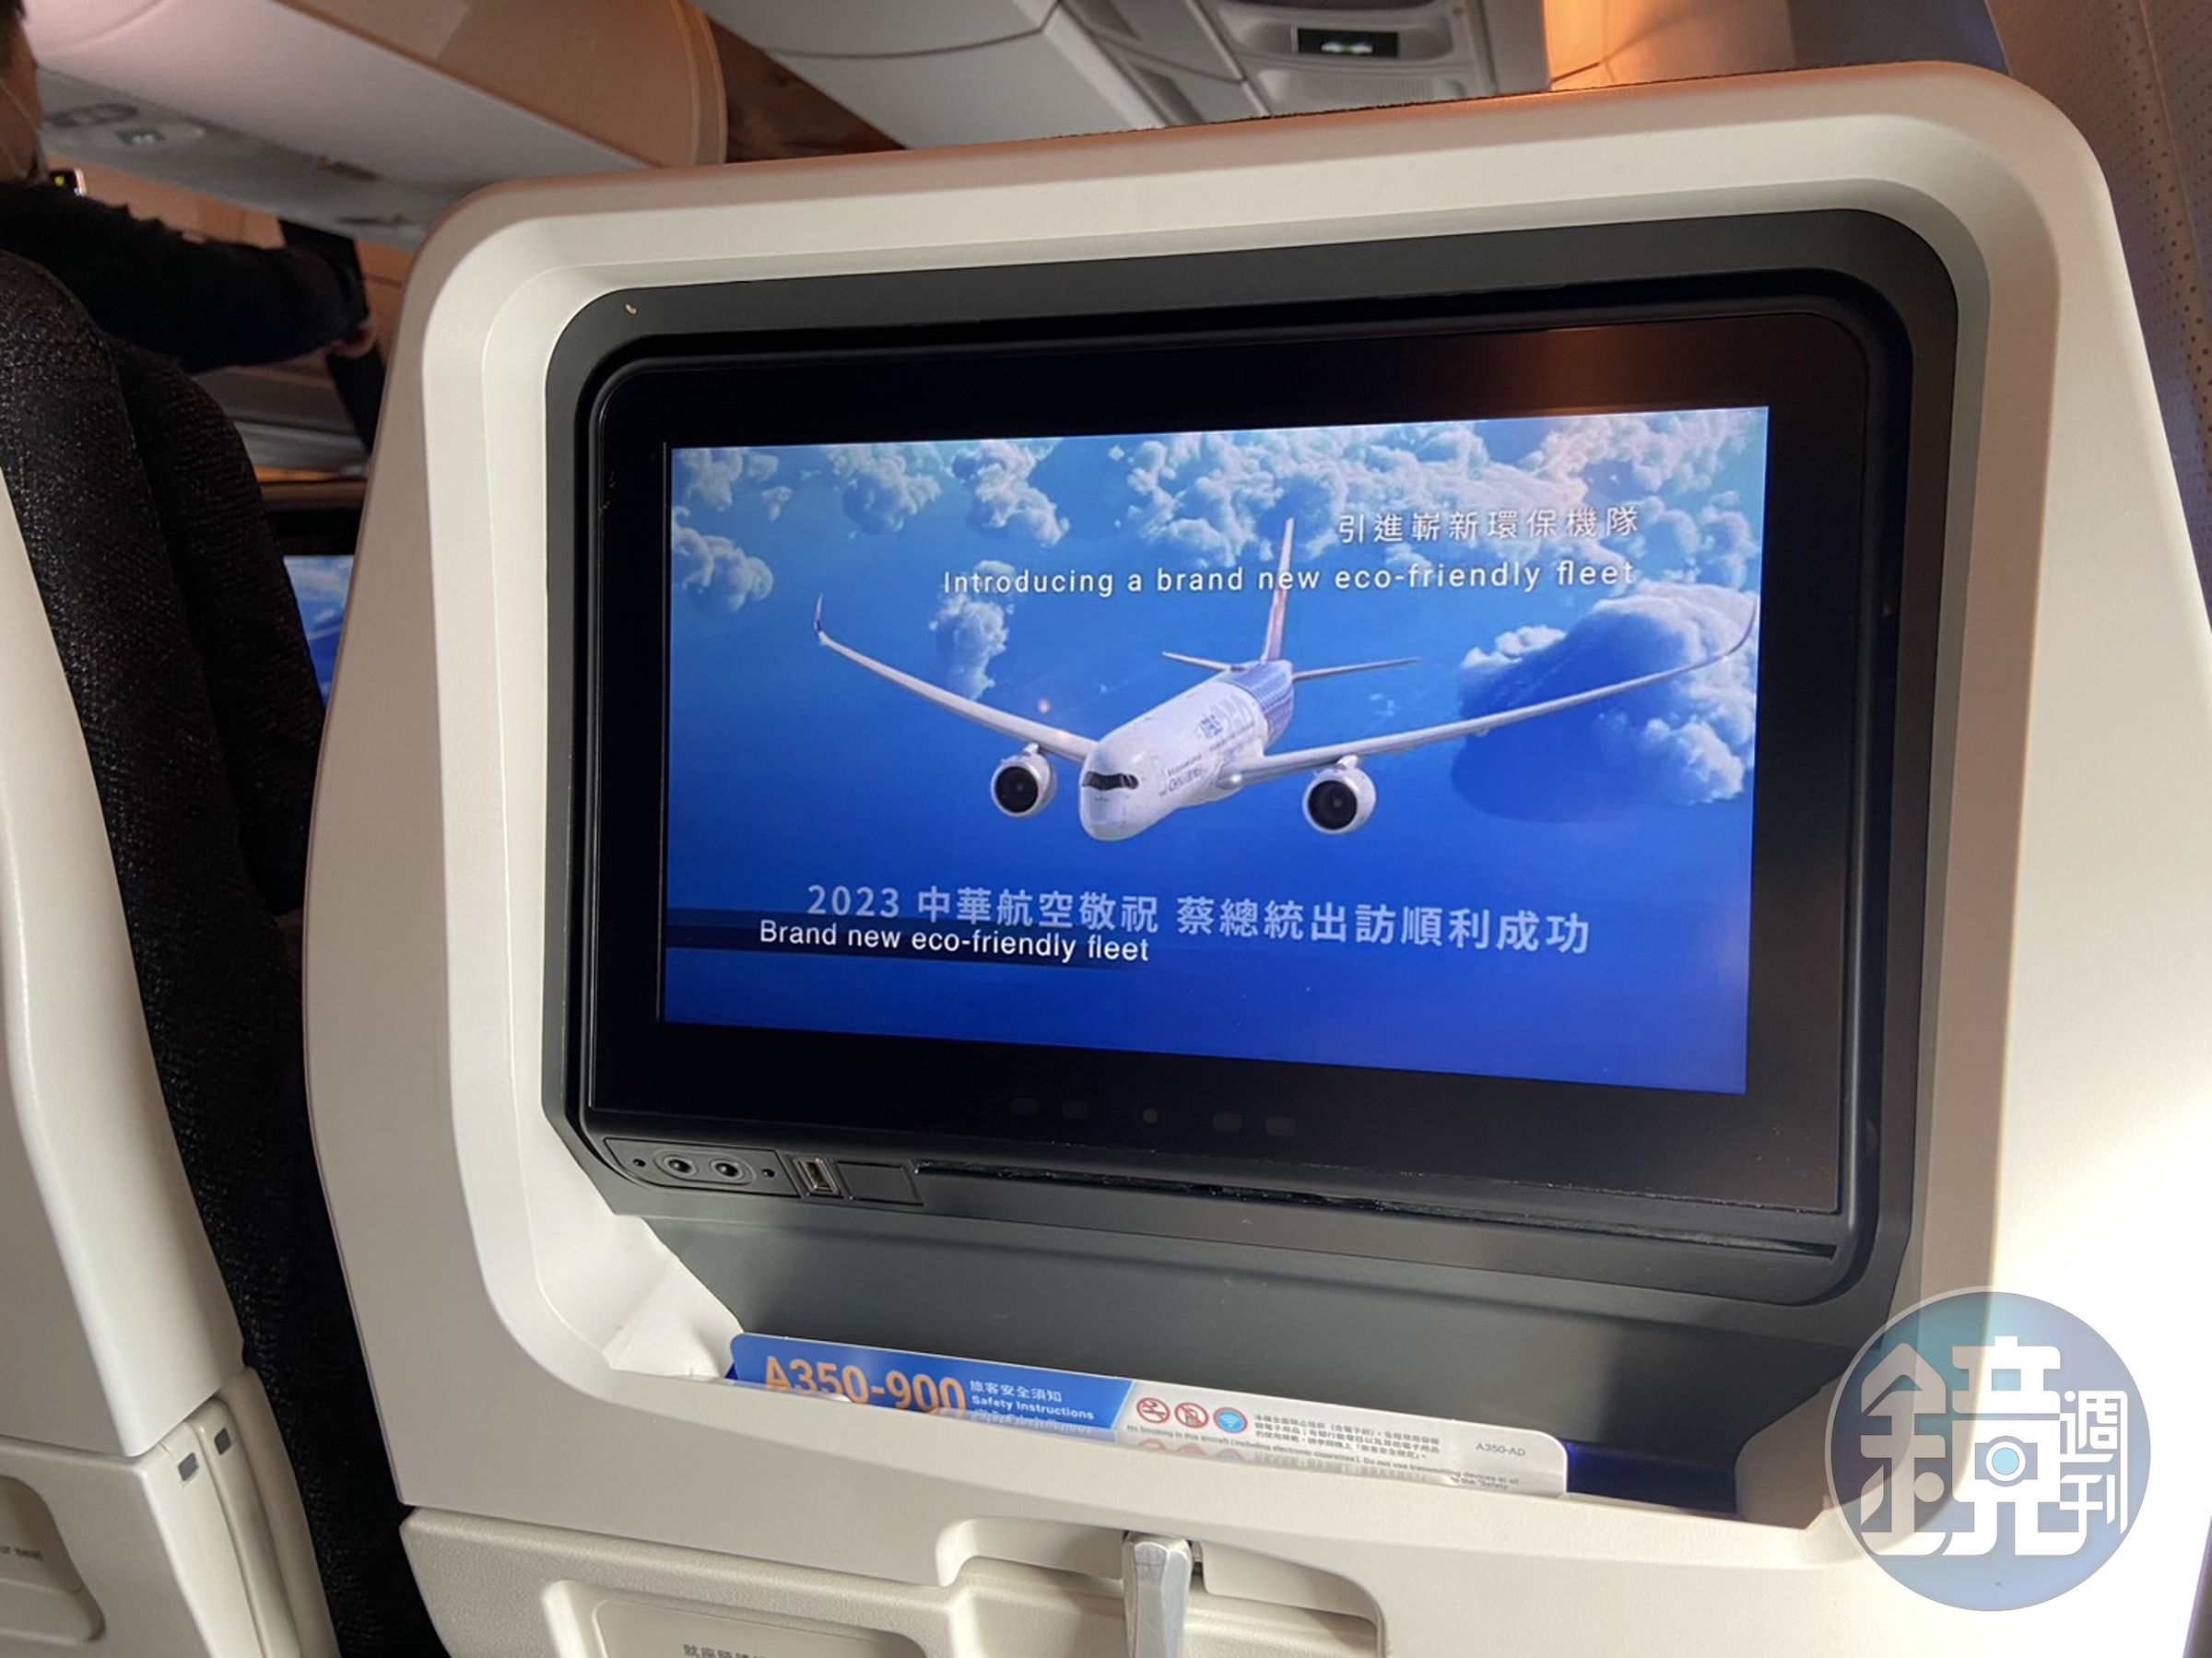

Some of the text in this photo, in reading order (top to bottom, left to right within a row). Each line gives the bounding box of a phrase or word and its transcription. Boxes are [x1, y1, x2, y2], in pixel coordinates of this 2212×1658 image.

[1336, 507, 1639, 544] 引進嶄新環保機隊
[943, 559, 1636, 597] Introducing a brand new eco-friendly fleet
[807, 885, 1589, 955] 2023 中華航空敬祝 蔡總統出訪順利成功
[759, 921, 1149, 963] Brand new eco-friendly fleet
[766, 1356, 967, 1412] A350-900
[970, 1380, 1063, 1403] 旅客安全須知
[971, 1394, 1095, 1420] Safety Instructions
[1476, 1442, 1525, 1456] A350-AD
